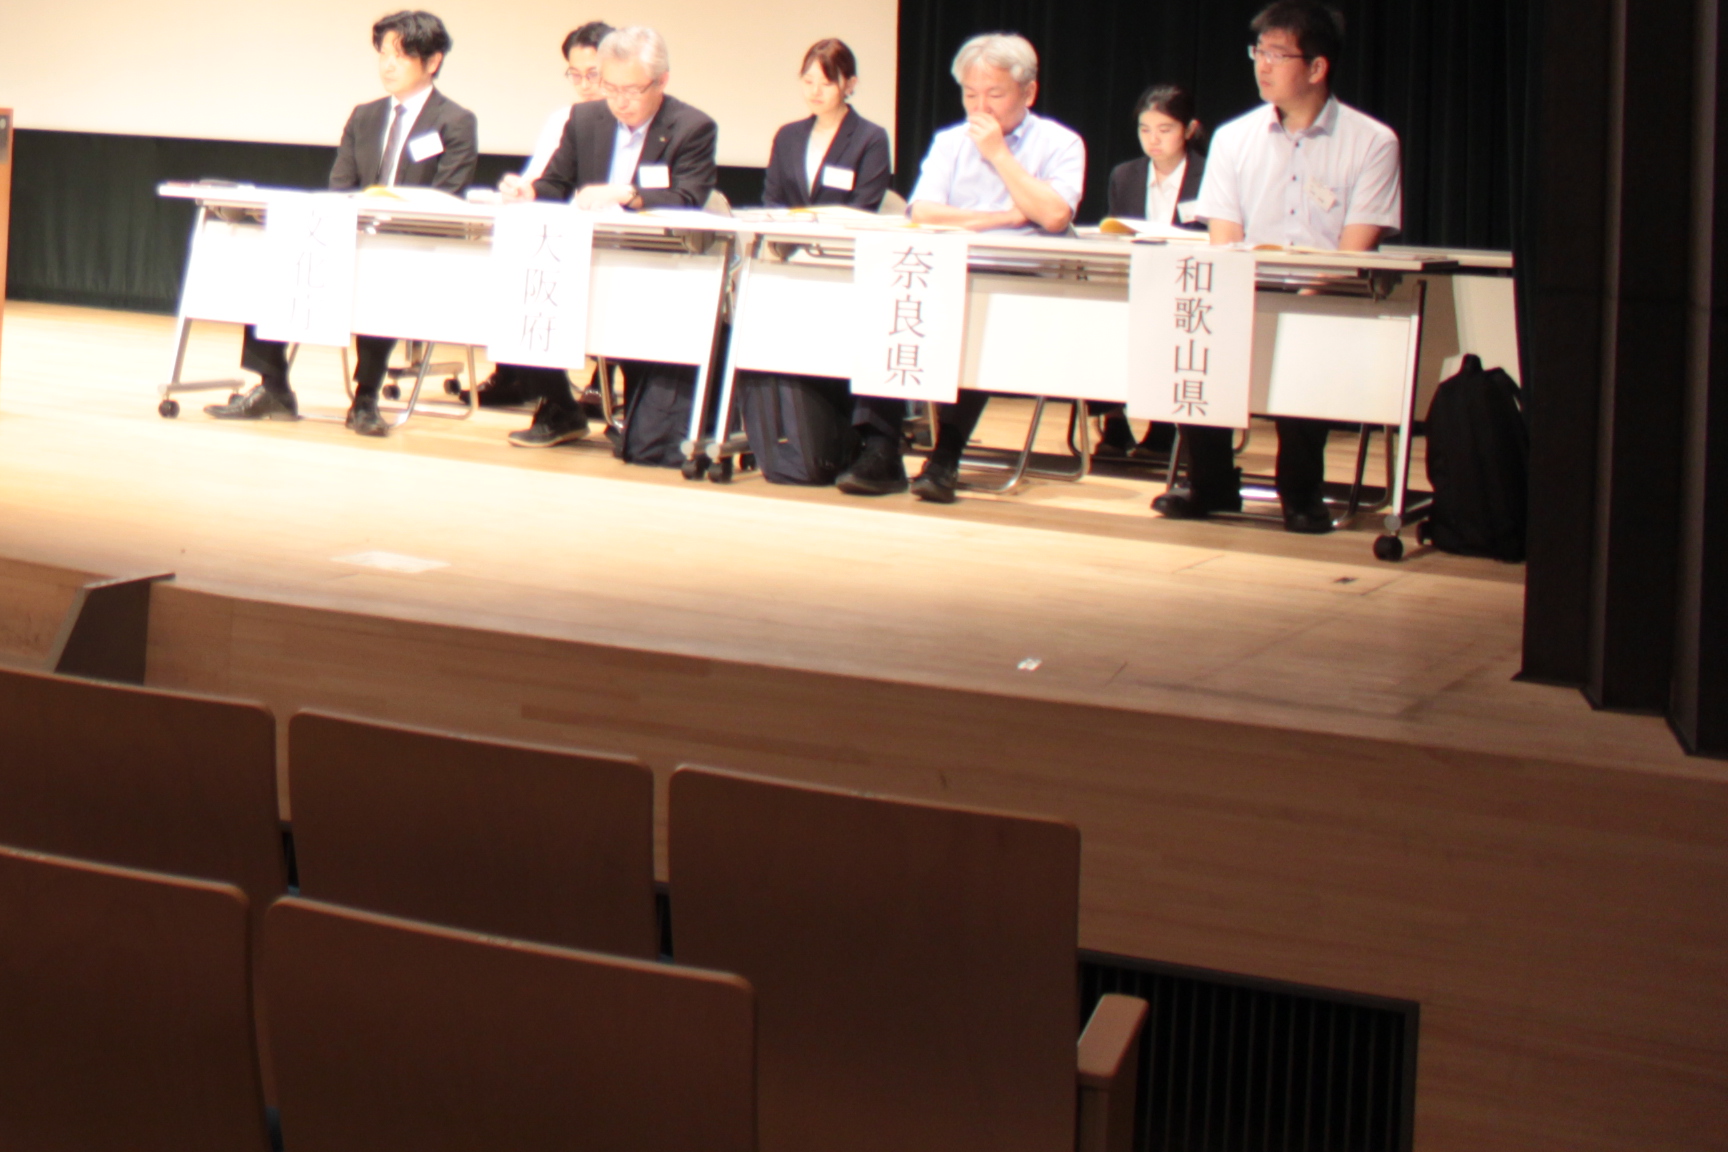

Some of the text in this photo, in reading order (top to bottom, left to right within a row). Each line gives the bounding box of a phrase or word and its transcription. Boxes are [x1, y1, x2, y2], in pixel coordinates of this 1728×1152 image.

[521, 223, 563, 353] 大阪府
[886, 245, 933, 387] 奈良県
[1172, 254, 1215, 419] 和歌山県
